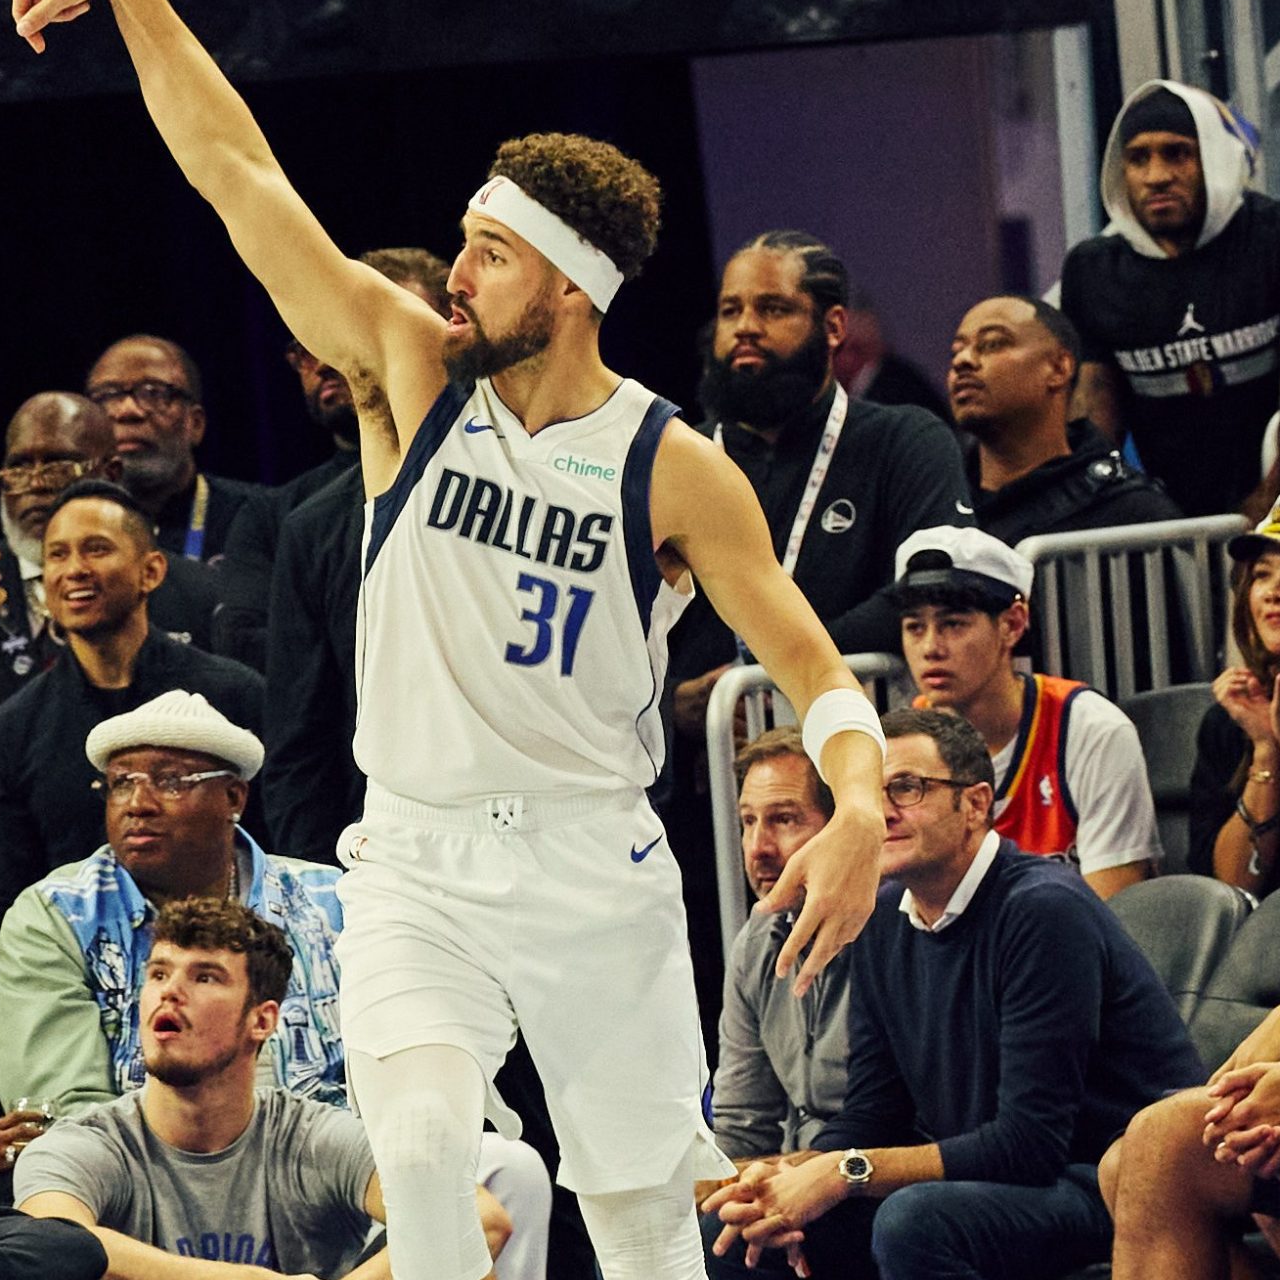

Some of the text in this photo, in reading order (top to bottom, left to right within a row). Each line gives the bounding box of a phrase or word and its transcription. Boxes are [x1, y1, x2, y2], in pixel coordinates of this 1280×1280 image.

[427, 467, 615, 573] DALLAS
[553, 455, 616, 481] chime
[504, 571, 596, 677] 31
